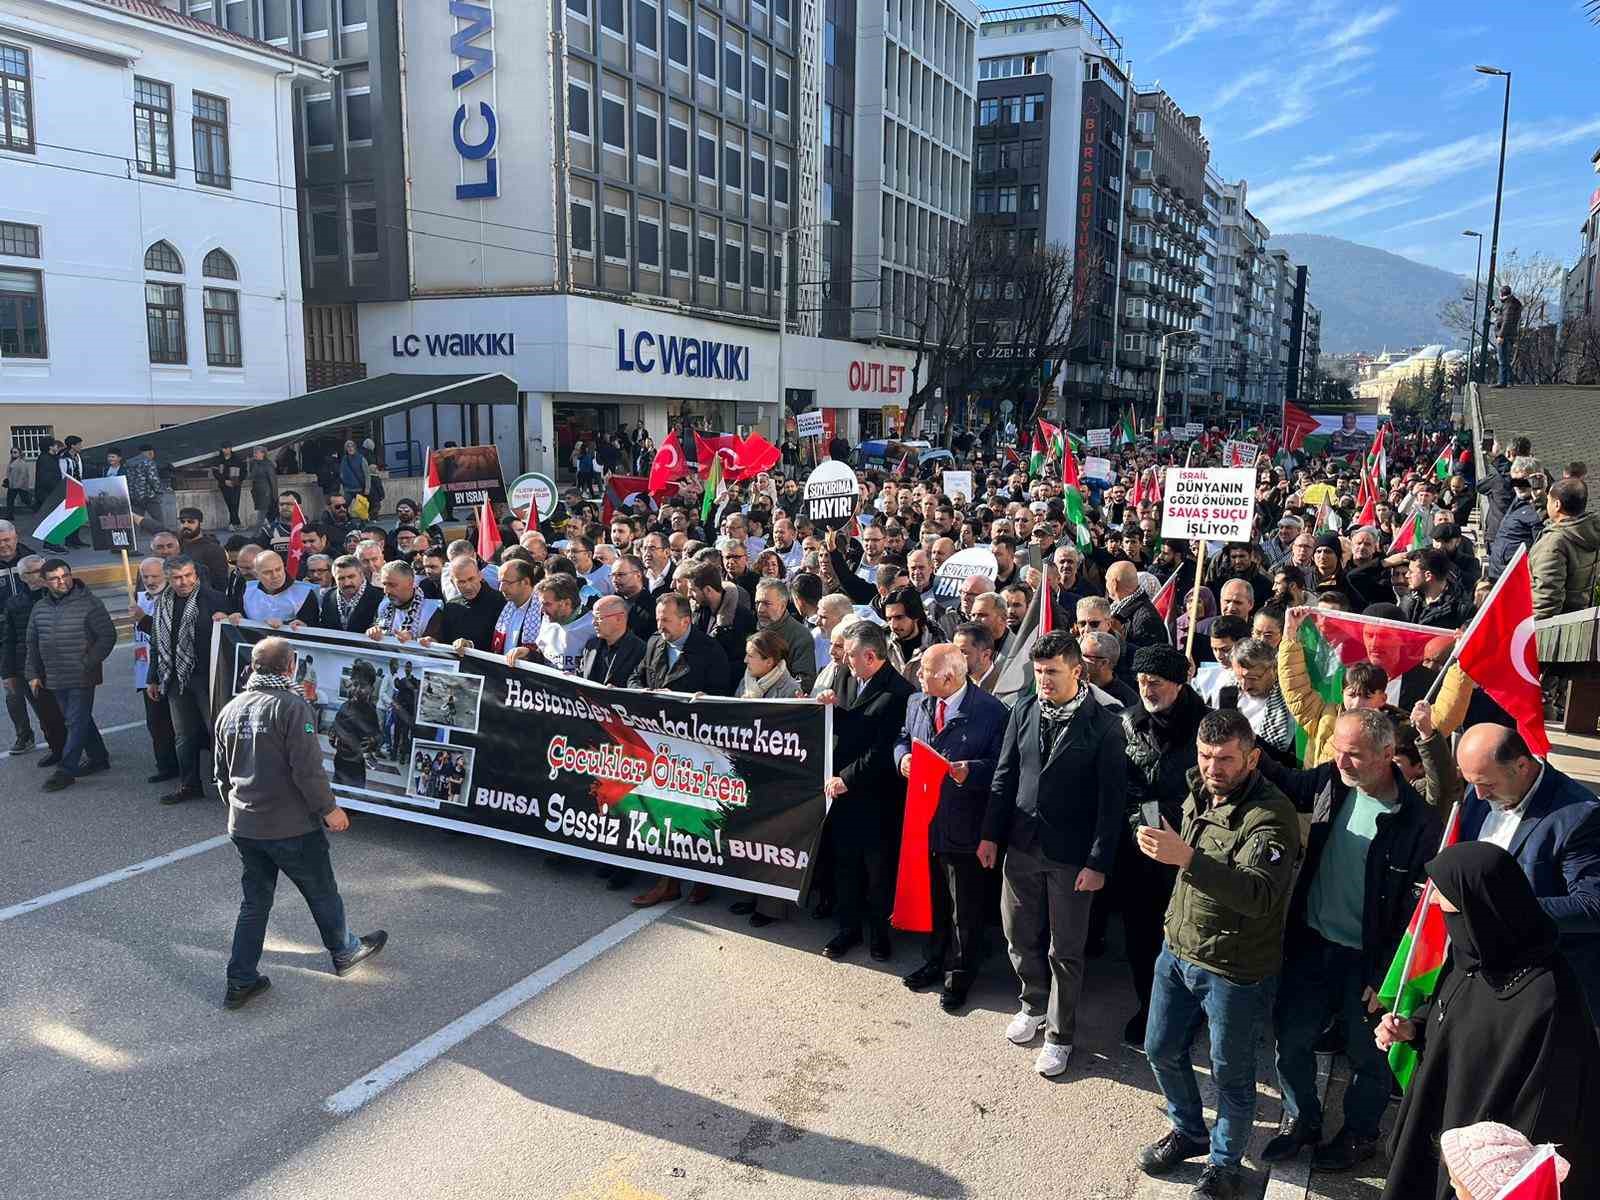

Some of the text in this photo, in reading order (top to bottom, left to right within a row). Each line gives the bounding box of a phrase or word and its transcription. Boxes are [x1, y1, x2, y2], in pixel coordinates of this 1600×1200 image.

[453, 101, 498, 200] LC
[392, 334, 421, 358] LC
[618, 328, 656, 373] LC
[849, 360, 907, 394] OUTLET
[1176, 480, 1243, 494] DÜNYANIN
[1179, 470, 1209, 480] İSRAİL
[455, 493, 465, 504] BY
[810, 496, 852, 520] HAYIR!
[1170, 494, 1249, 506] GÖZÜ ÖNÜNDE
[1168, 507, 1248, 522] SAVAŞ SUÇU
[1186, 520, 1239, 537] İŞLİYOR
[505, 678, 613, 724] Hastaneler
[547, 734, 749, 808] Çocuklar Ölürken
[475, 787, 541, 818] BURSA
[544, 792, 725, 867] Sessiz Kalma!
[729, 838, 809, 869] BURSA
